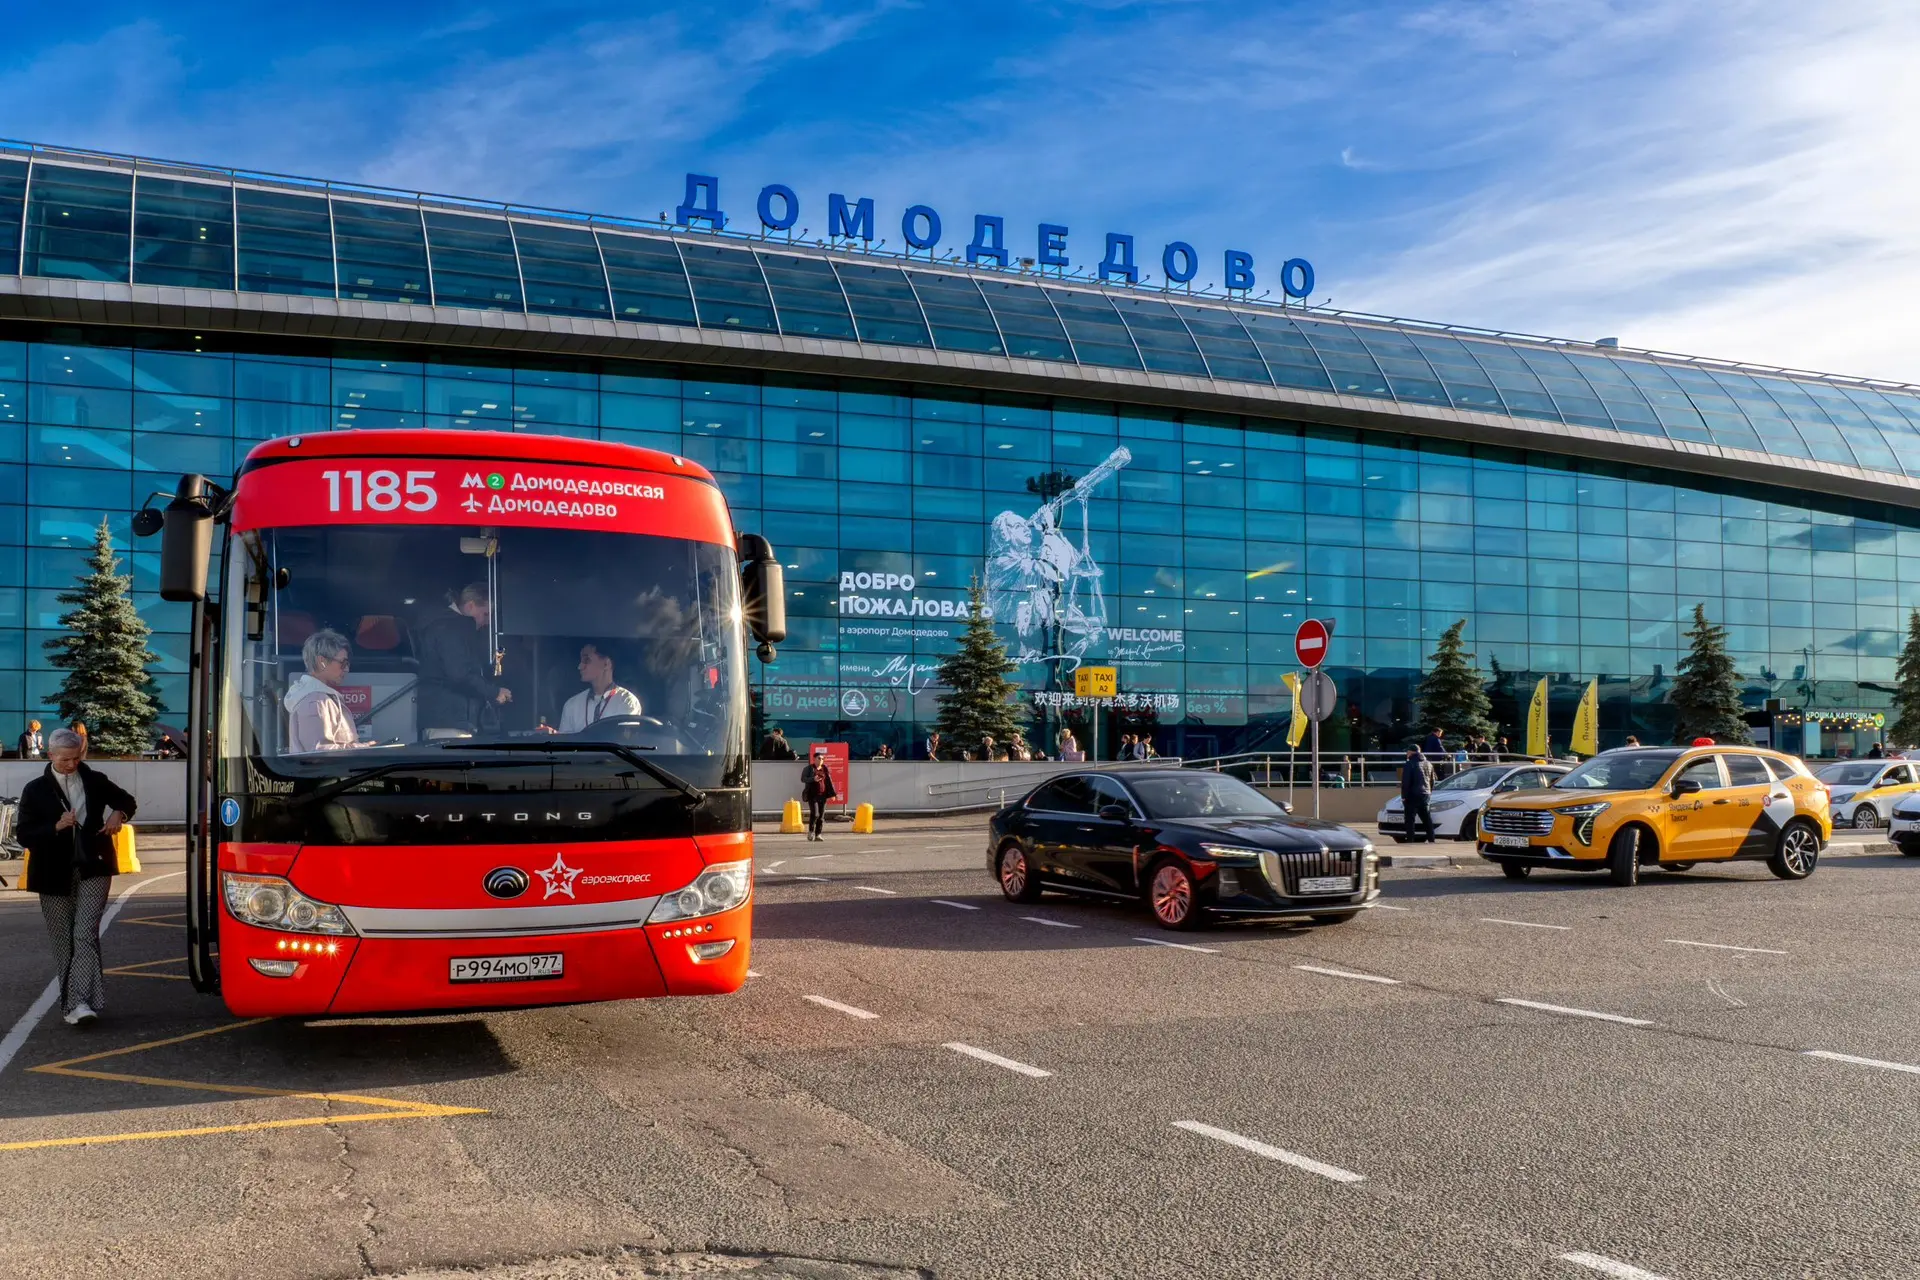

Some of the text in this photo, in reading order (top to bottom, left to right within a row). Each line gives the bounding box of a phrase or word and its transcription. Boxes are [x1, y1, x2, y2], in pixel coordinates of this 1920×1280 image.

[676, 173, 1315, 298] ДОМОДЕДОВО
[322, 470, 437, 512] 1185
[510, 473, 664, 499] Домодедовская
[488, 495, 617, 517] Домодедово
[839, 571, 915, 592] ДОБРО
[847, 627, 890, 636] аэропорт
[892, 627, 948, 637] Домодедово
[1107, 628, 1183, 642] WELCOME
[840, 664, 870, 672] имени
[1078, 673, 1089, 682] TAXI
[1094, 673, 1113, 682] TAXI
[766, 693, 793, 706] 150
[797, 693, 837, 709] дней
[873, 695, 888, 708] %
[1187, 701, 1211, 713] без
[1214, 701, 1227, 713] %
[1806, 711, 1873, 720] КРОШКА КАРТОШКА
[416, 812, 592, 823] YUTONG
[581, 873, 651, 886] аэроэкспресс
[456, 956, 558, 977] Р994МО 977
